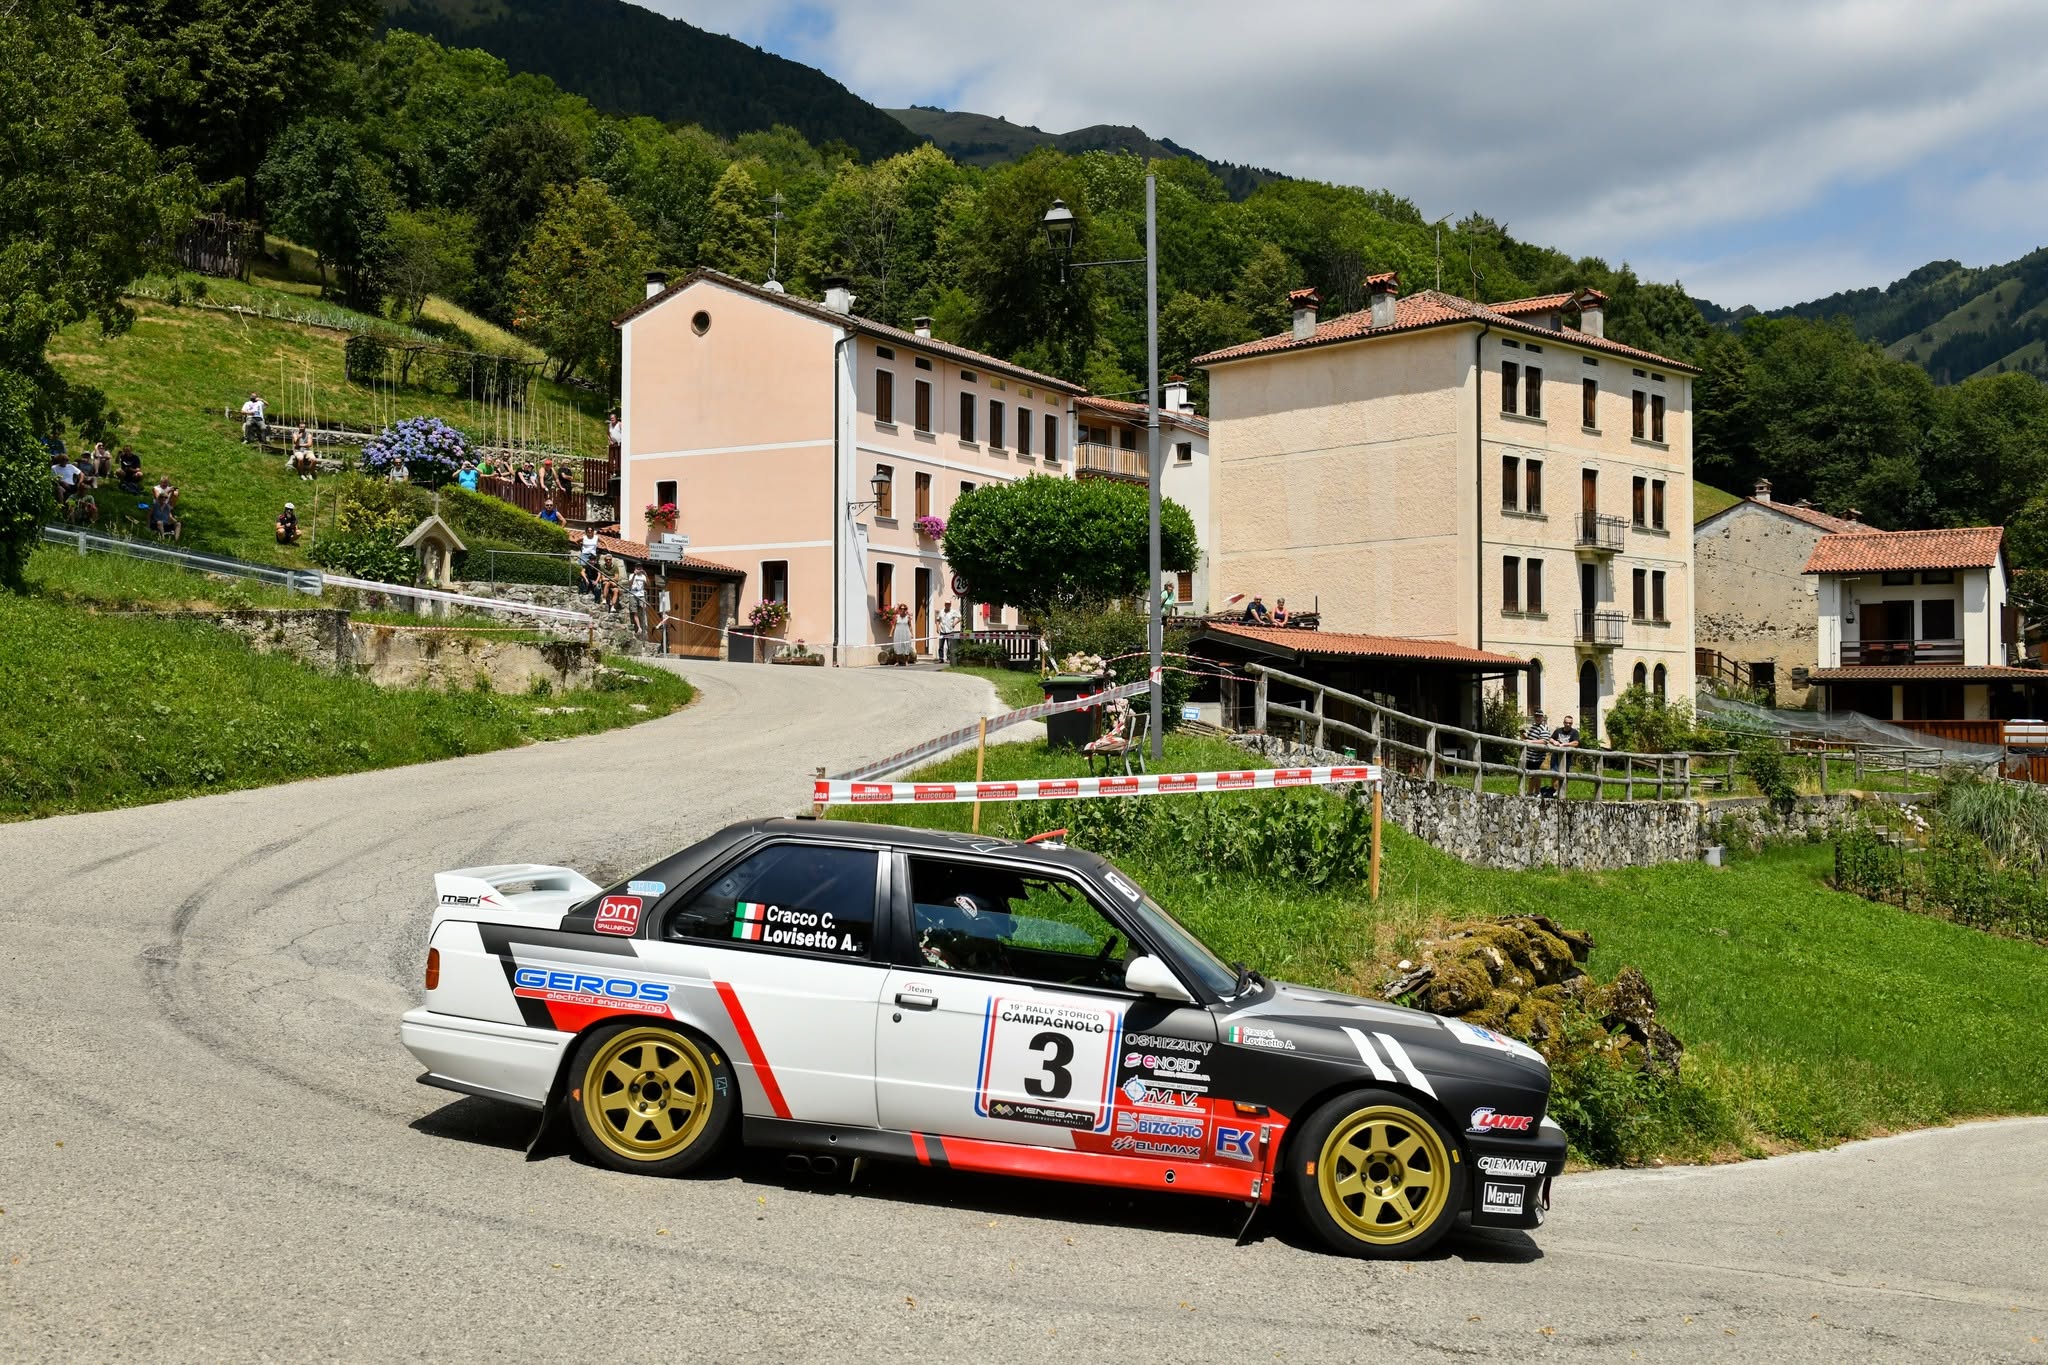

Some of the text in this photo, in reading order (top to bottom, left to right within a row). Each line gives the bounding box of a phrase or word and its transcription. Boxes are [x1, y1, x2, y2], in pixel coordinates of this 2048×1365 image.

[601, 899, 638, 920] bm
[766, 905, 836, 929] Cracco C.
[763, 924, 858, 951] Lovisetto A.
[516, 968, 670, 1002] GEROS
[546, 992, 662, 1012] electrical engineering
[1002, 1011, 1104, 1034] CAMPAGNOLO
[1026, 1005, 1054, 1015] RALLY
[1057, 1009, 1100, 1021] STORICO
[1125, 1033, 1213, 1056] OSHIZAKY
[1243, 1035, 1296, 1050] Lovisetto A.
[1024, 1032, 1074, 1102] 3
[1149, 1088, 1198, 1107] M. V.
[1016, 1106, 1093, 1122] MENEGATTI
[1138, 1120, 1203, 1139] BIZZOTTO
[1135, 1141, 1200, 1156] BLUMAX
[1478, 1156, 1547, 1174] CIEMMEVI
[1487, 1185, 1521, 1205] Maran
